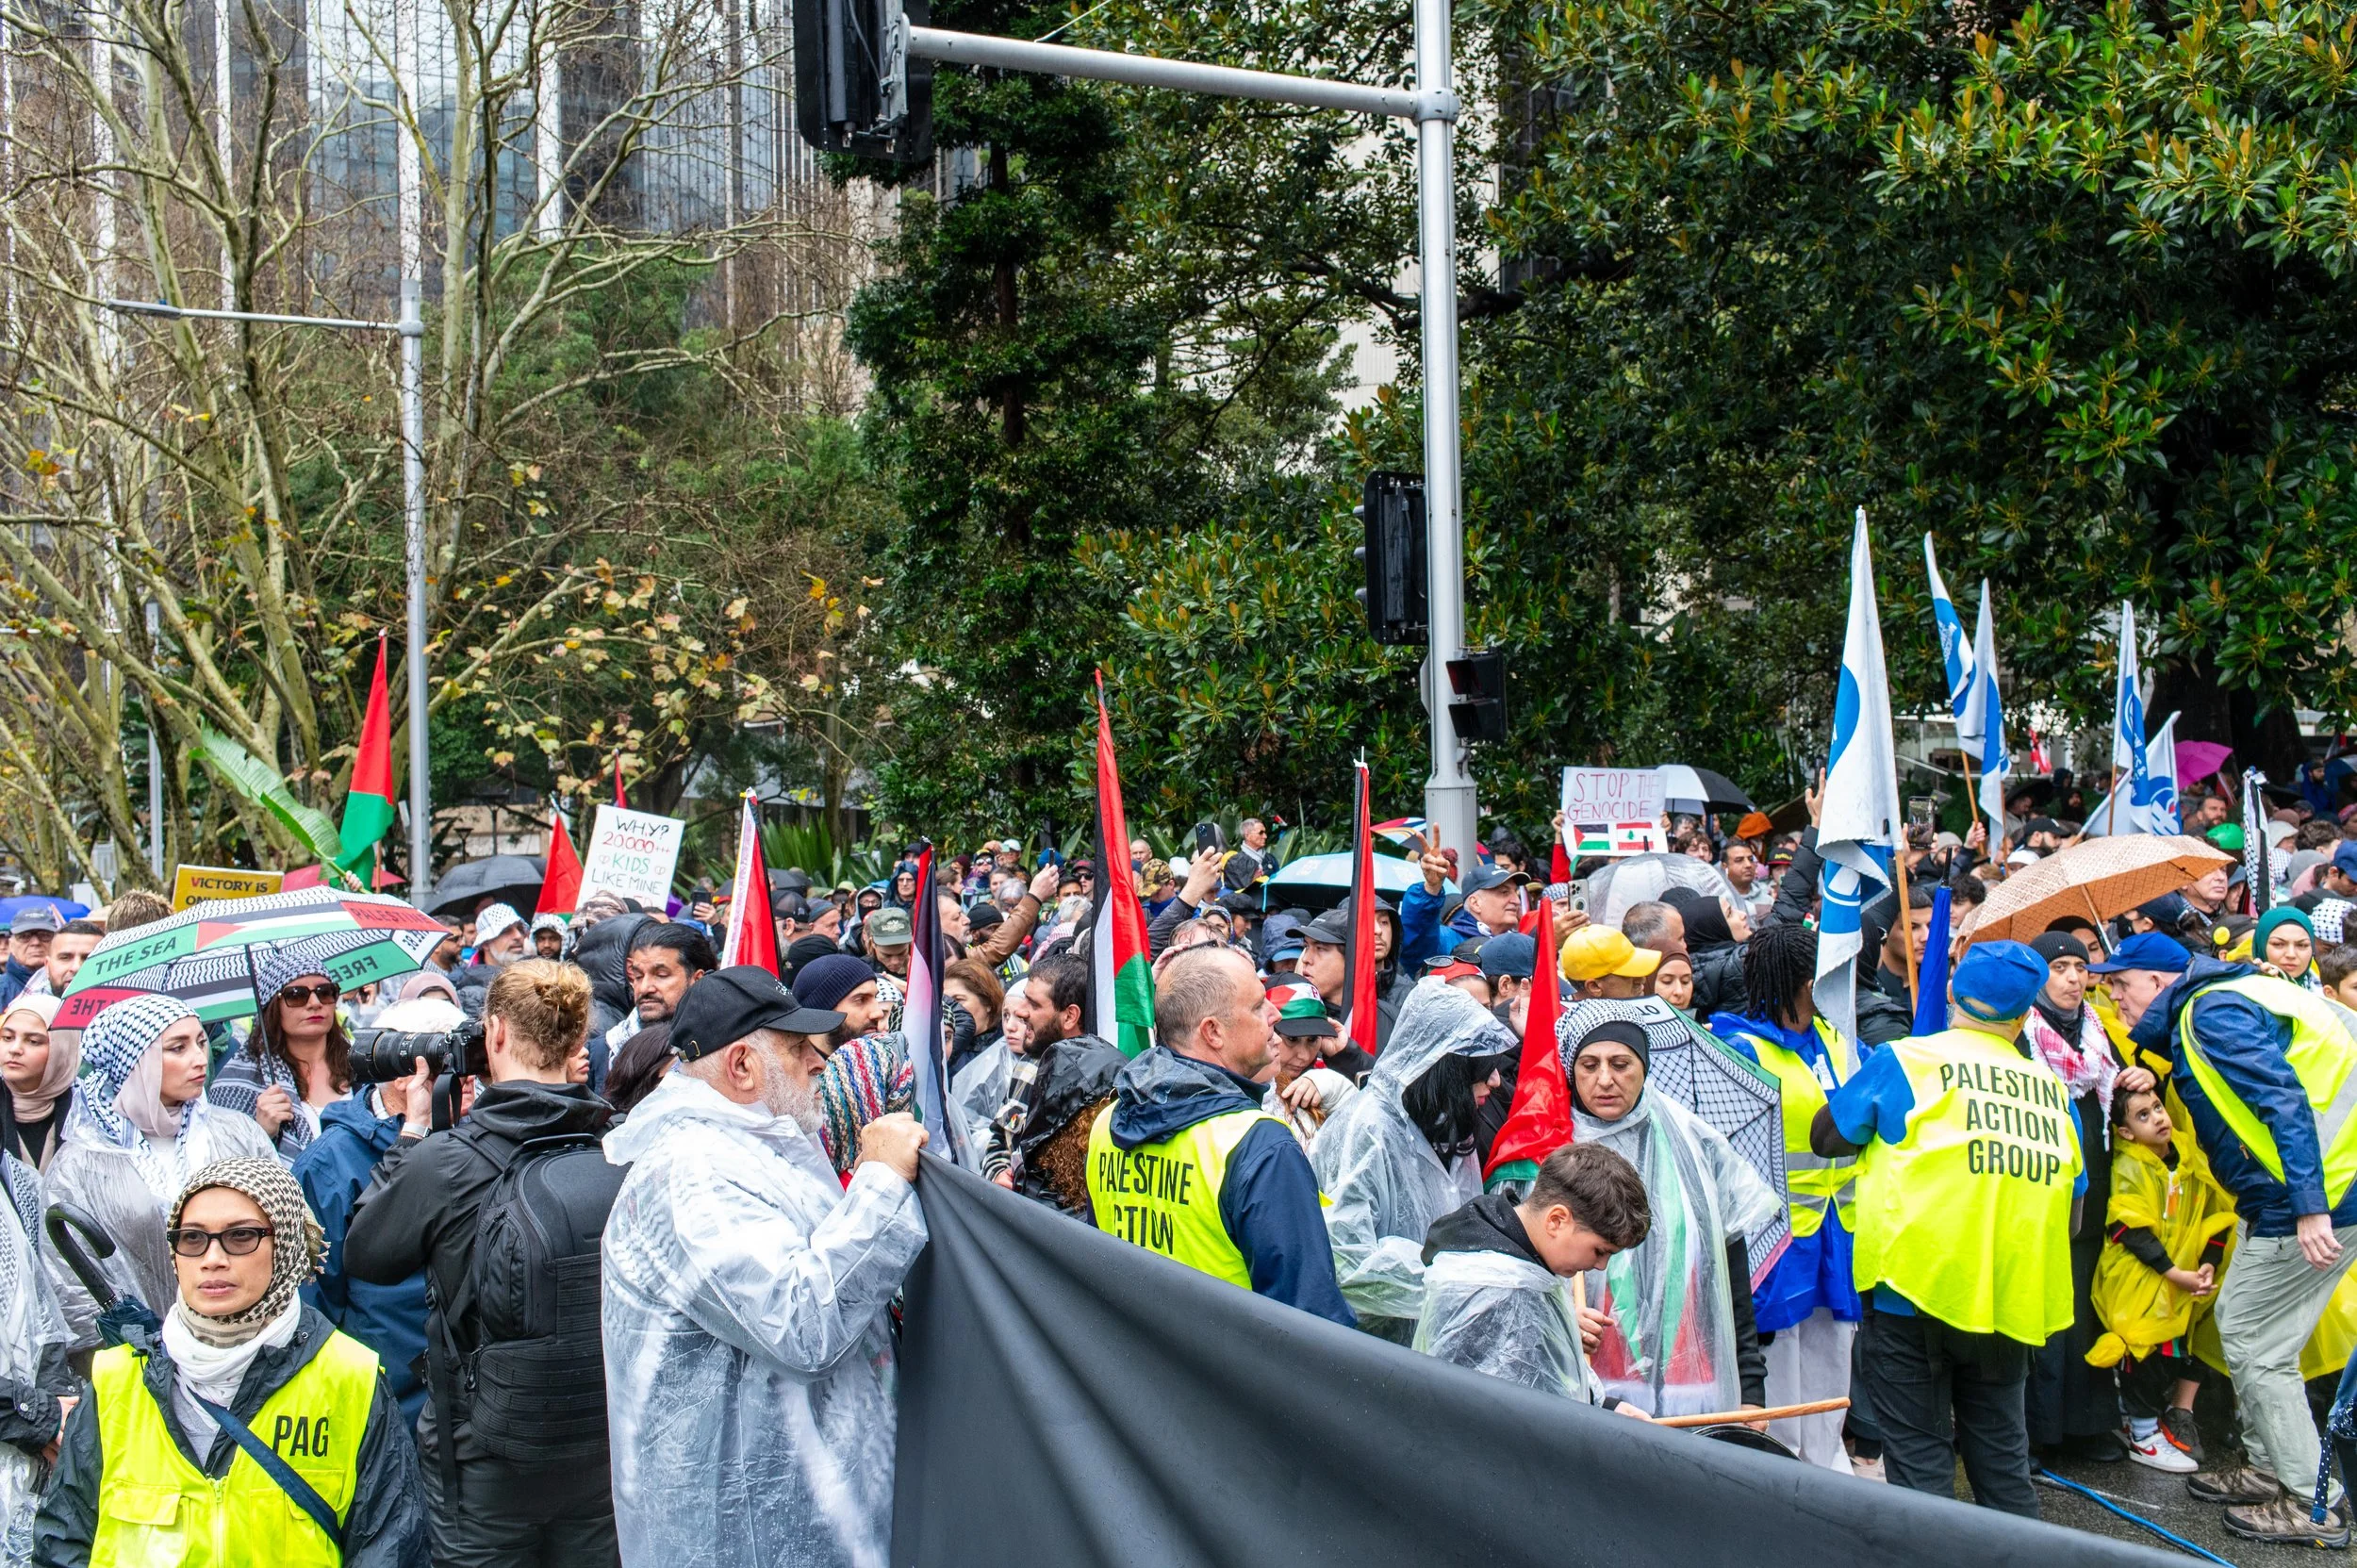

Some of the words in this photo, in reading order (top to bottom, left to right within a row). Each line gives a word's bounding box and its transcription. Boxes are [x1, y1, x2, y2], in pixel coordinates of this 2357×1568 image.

[1574, 772, 1630, 802] STOP
[1638, 774, 1660, 798] THE
[1567, 800, 1652, 821] GENOCIDE
[616, 815, 669, 840] WHY?
[612, 851, 651, 875] KIDS
[191, 876, 253, 892] VICTORY
[255, 882, 269, 893] IS
[591, 867, 627, 888] LIKE
[628, 875, 663, 896] MINE
[185, 895, 224, 906] ON
[96, 950, 136, 976] THE
[138, 935, 177, 961] SEA
[1966, 1098, 2060, 1147] ACTION
[1968, 1139, 2060, 1186] GROUP
[272, 1414, 330, 1458] PAG
